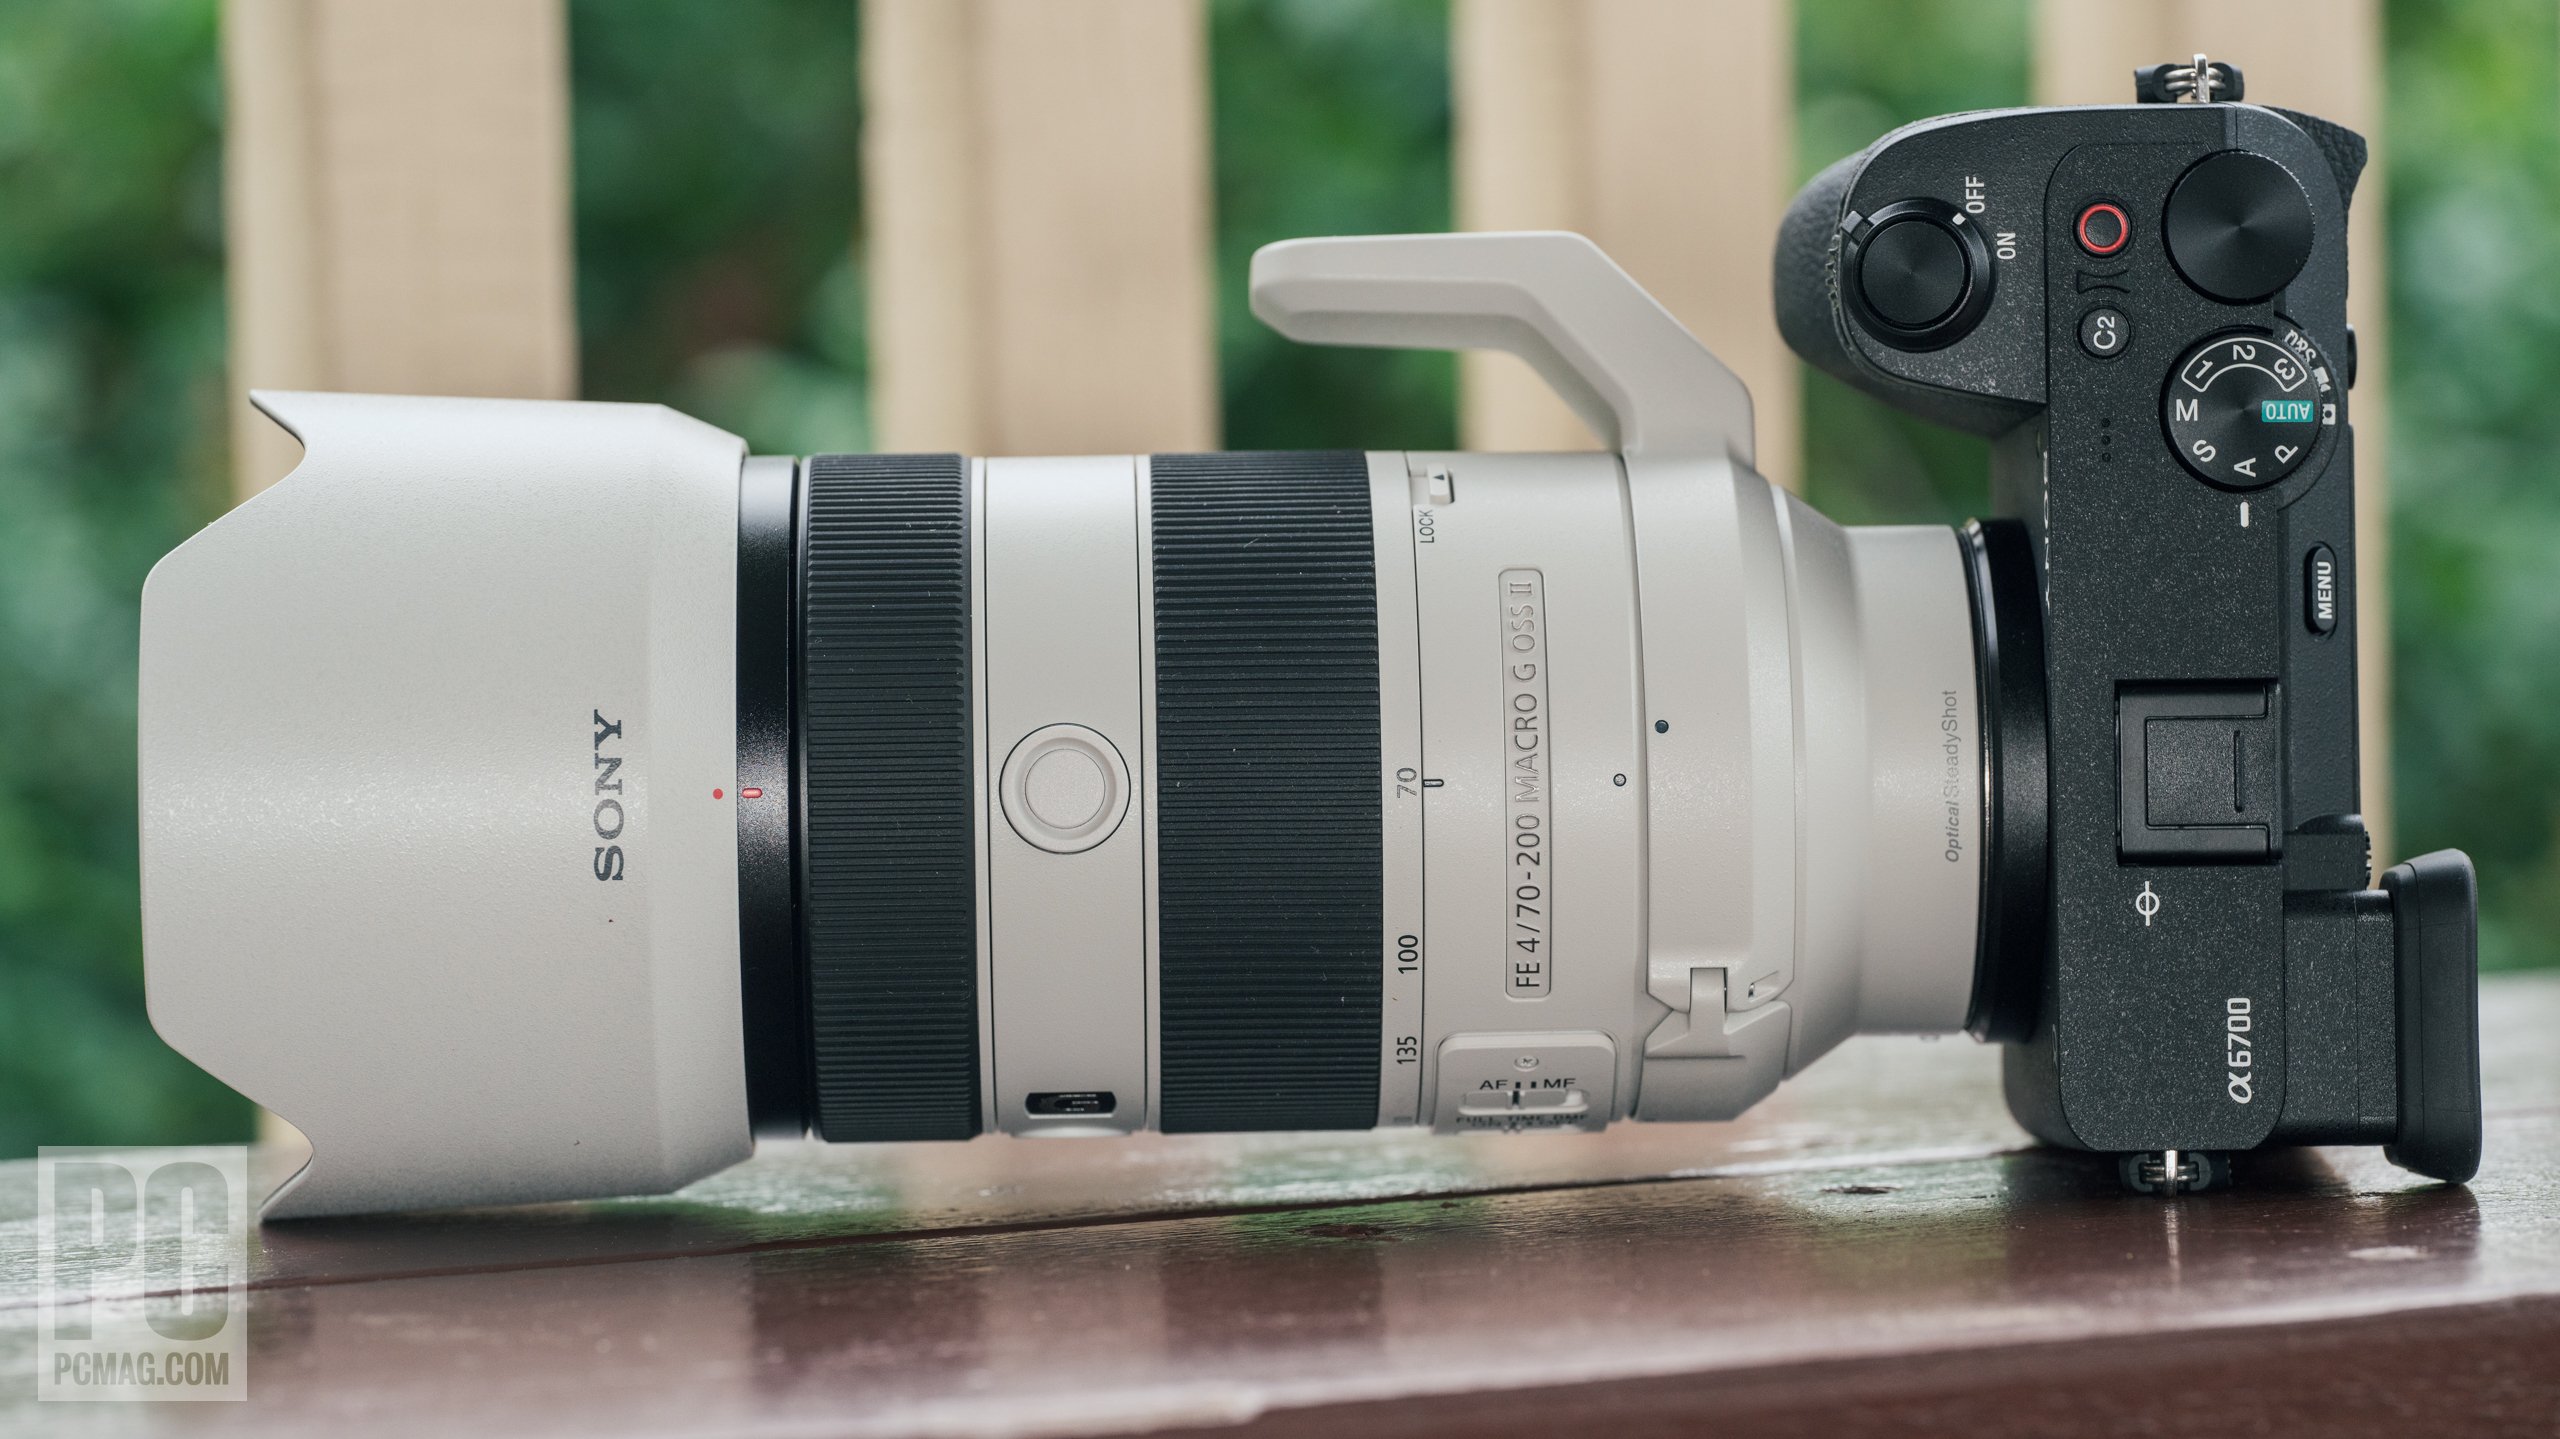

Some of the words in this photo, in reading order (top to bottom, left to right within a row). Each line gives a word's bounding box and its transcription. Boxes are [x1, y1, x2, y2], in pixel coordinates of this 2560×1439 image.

[1965, 175, 1985, 214] OFF
[1996, 232, 2016, 260] ON
[2093, 316, 2116, 350] C2
[2195, 359, 2213, 379] 1
[2232, 344, 2256, 361] 2
[2273, 358, 2296, 381] 3
[2175, 398, 2198, 422] M
[2265, 403, 2310, 420] AUTO
[2192, 439, 2216, 463] S
[2274, 444, 2299, 464] P
[2233, 457, 2257, 478] A
[1418, 509, 1435, 543] LOCK
[1509, 582, 1533, 596] II
[2317, 561, 2333, 619] MENU
[1509, 604, 1536, 652] OSS
[1512, 662, 1537, 682] G
[1513, 692, 1540, 802] MACRO
[593, 708, 625, 882] SONY
[1396, 766, 1417, 799] 70
[1515, 813, 1540, 954] 4/70-200
[1397, 934, 1419, 974] 100
[1515, 962, 1540, 988] FE
[1396, 1035, 1417, 1066] 135
[1479, 1079, 1508, 1090] AF
[1543, 1078, 1576, 1089] MF
